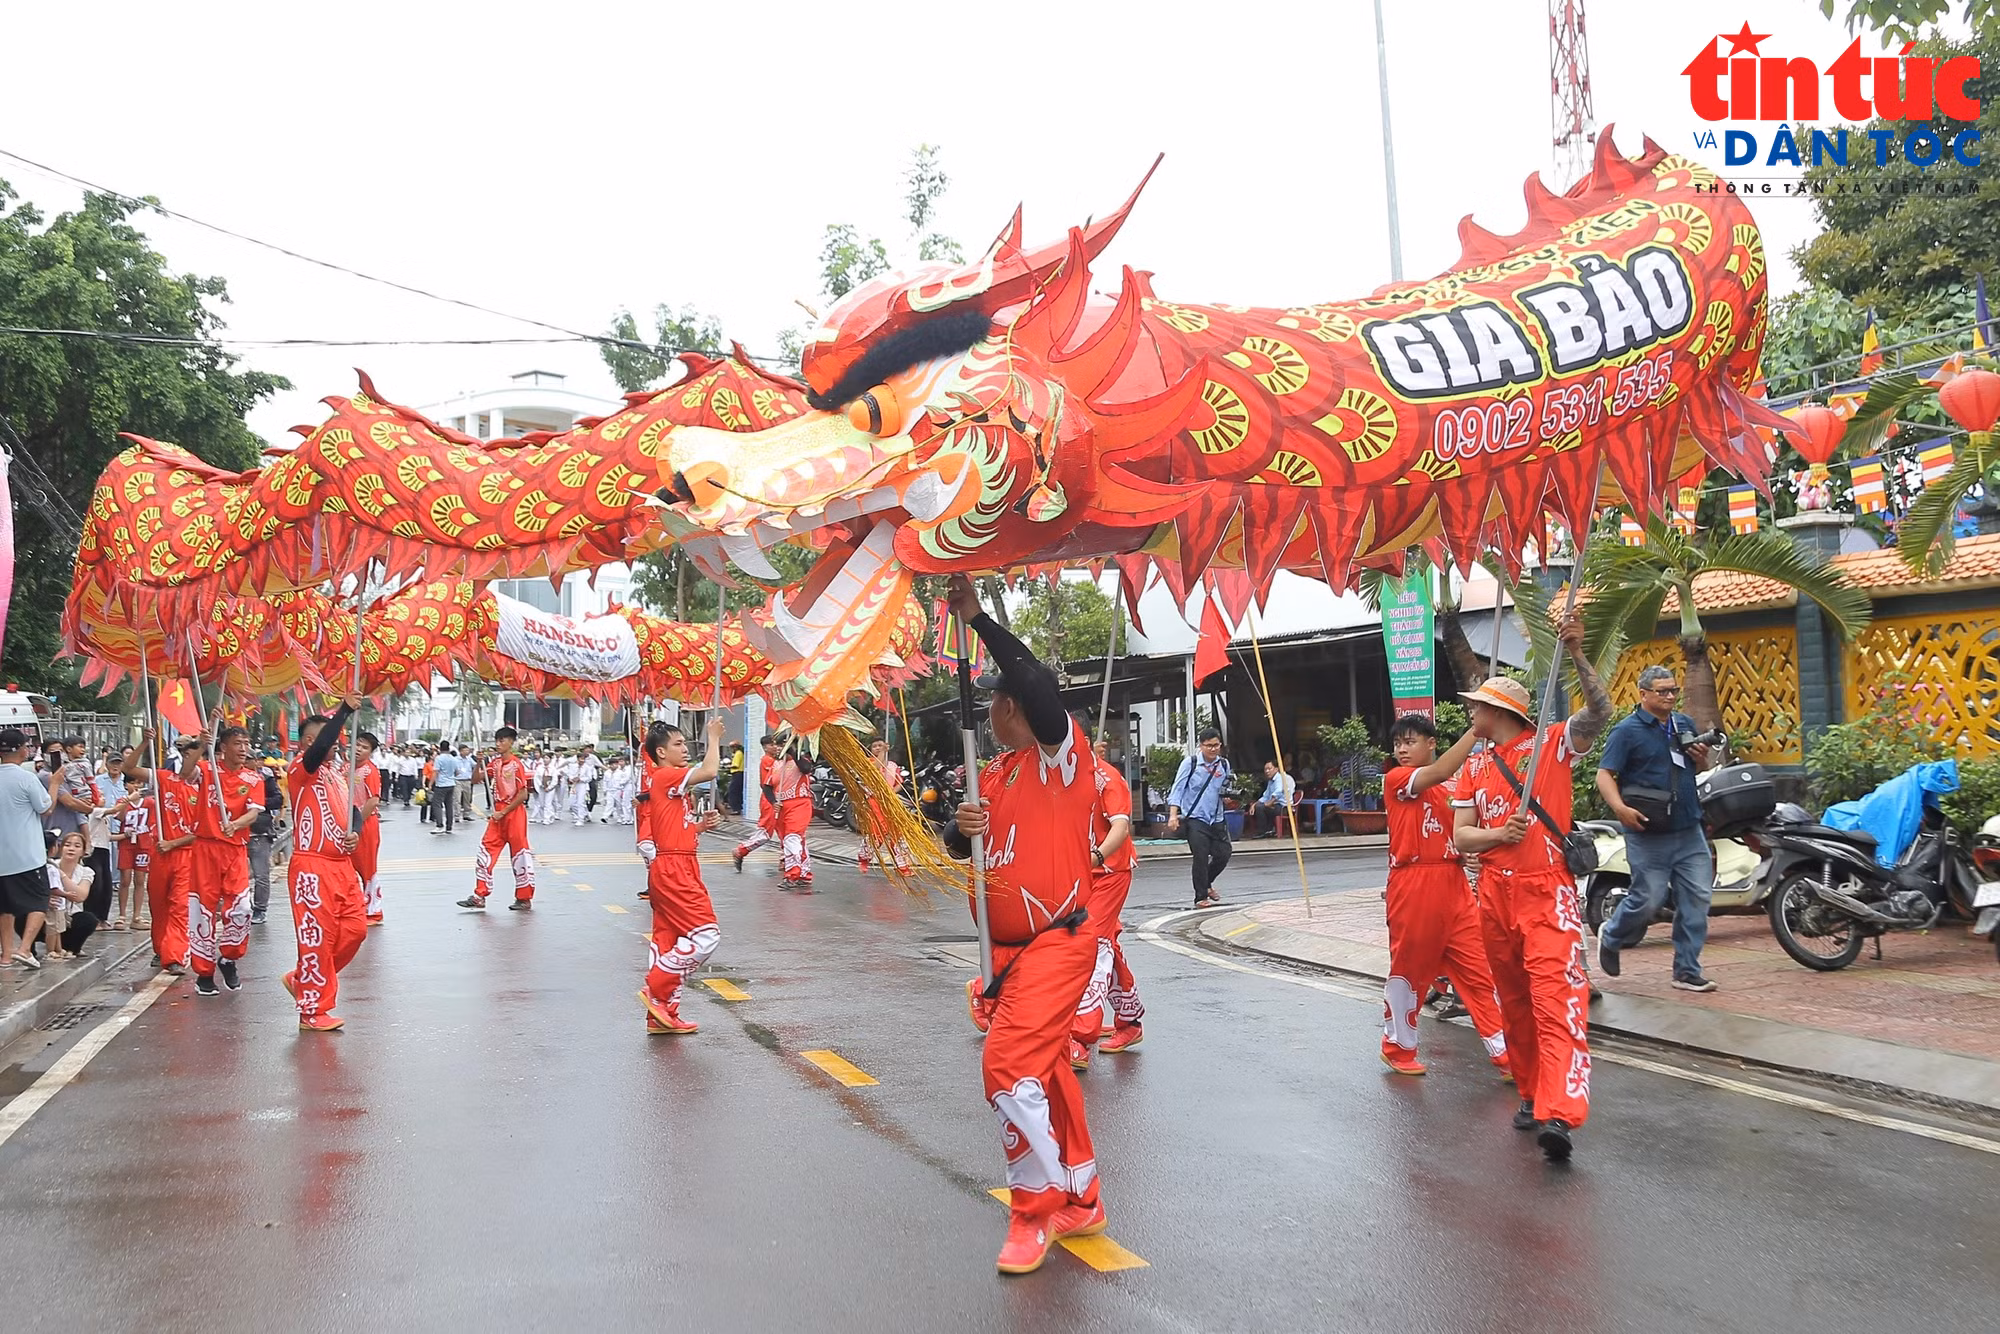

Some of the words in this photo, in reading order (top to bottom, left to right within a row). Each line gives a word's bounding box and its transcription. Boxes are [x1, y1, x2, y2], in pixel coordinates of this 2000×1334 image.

[1369, 306, 1536, 391] GIA
[1524, 249, 1685, 366] BẢO
[1434, 400, 1534, 462] 0902
[1540, 379, 1604, 440] 531
[1610, 350, 1670, 416] 535
[523, 616, 617, 652] HANSINCO
[124, 808, 150, 834] 97
